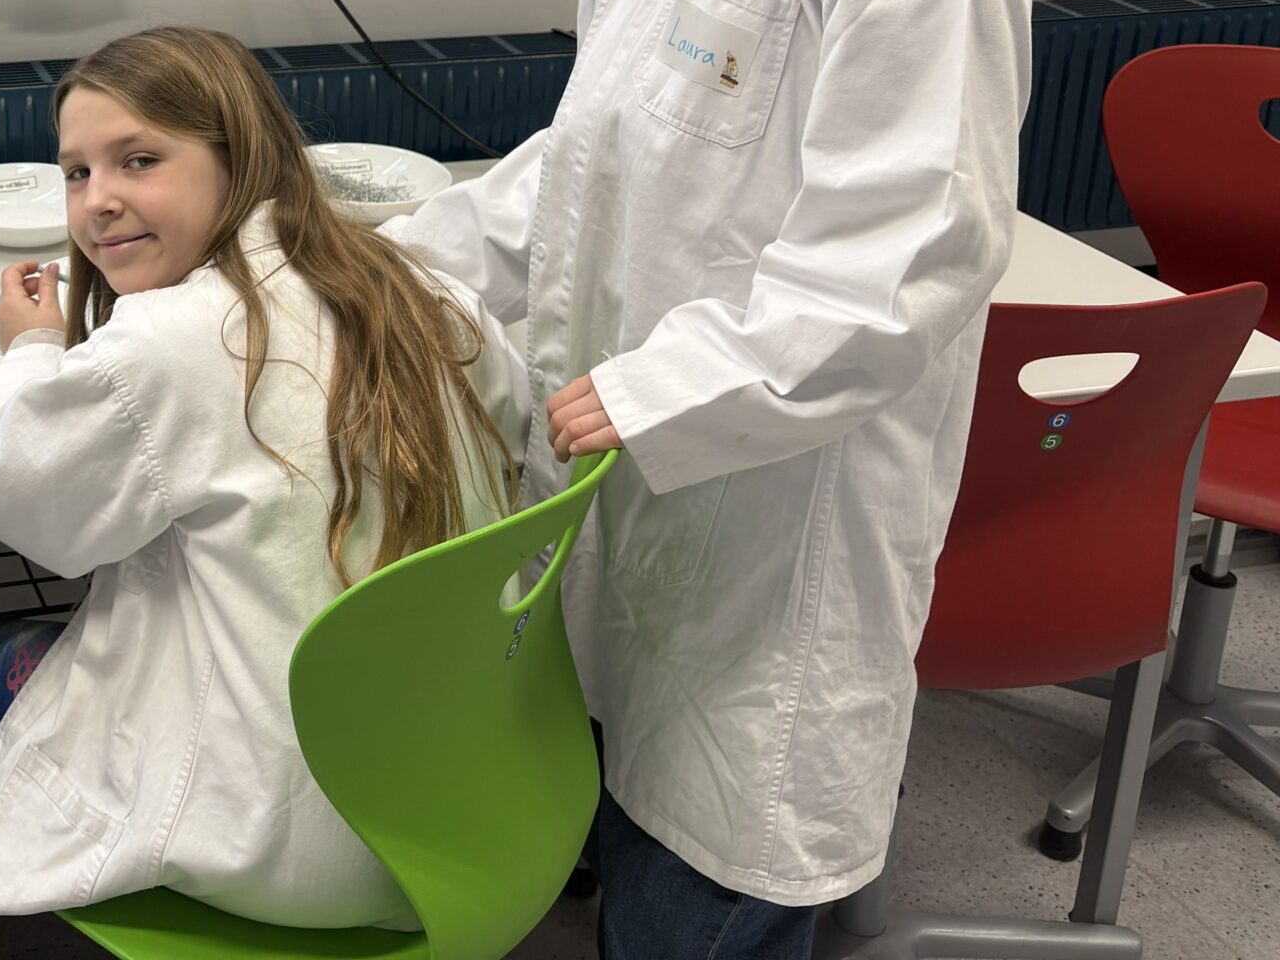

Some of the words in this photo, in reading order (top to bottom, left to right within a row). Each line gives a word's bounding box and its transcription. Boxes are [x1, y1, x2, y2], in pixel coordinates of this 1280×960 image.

[667, 15, 716, 69] Laura
[1053, 413, 1066, 427] 6
[1045, 435, 1057, 449] 5
